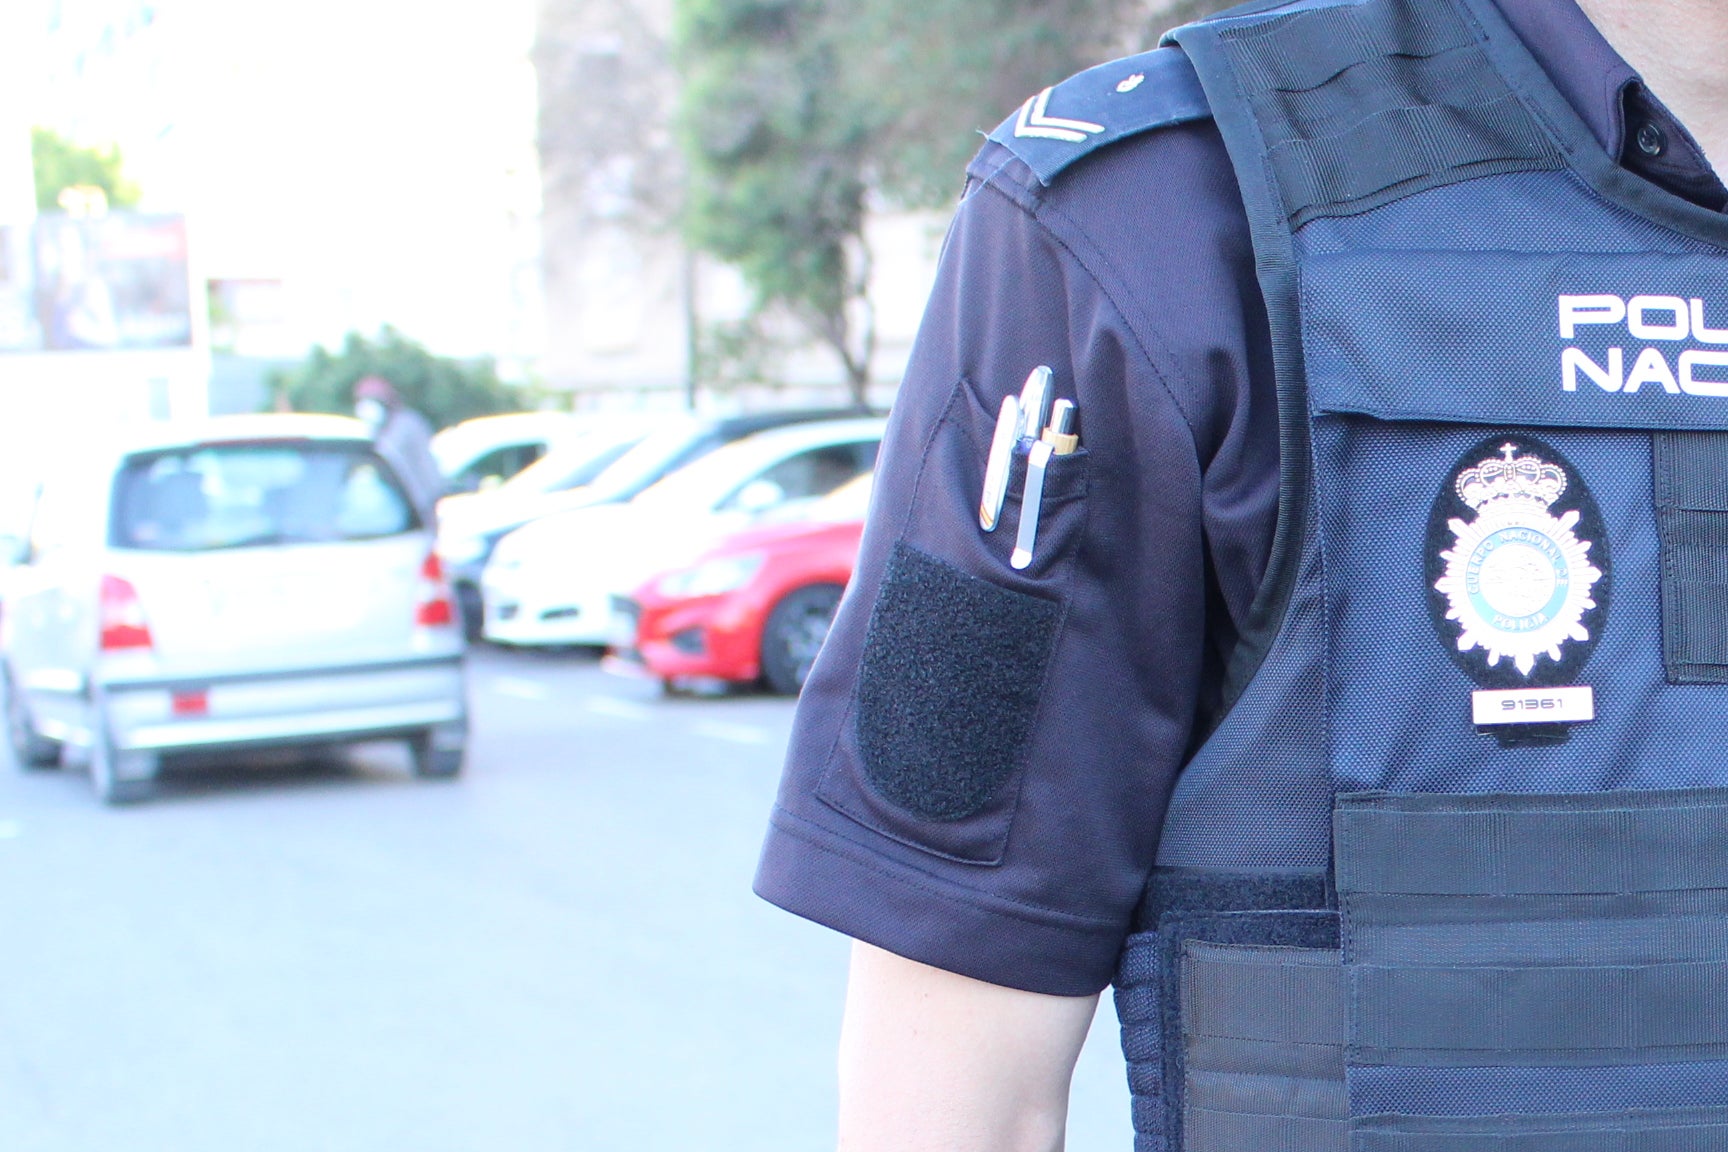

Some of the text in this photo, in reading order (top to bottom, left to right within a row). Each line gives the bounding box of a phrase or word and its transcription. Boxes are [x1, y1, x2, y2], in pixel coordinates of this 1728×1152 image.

[1466, 539, 1495, 595] CUERPO
[1498, 529, 1562, 566] NACIONAL
[1501, 698, 1564, 711] 91361
